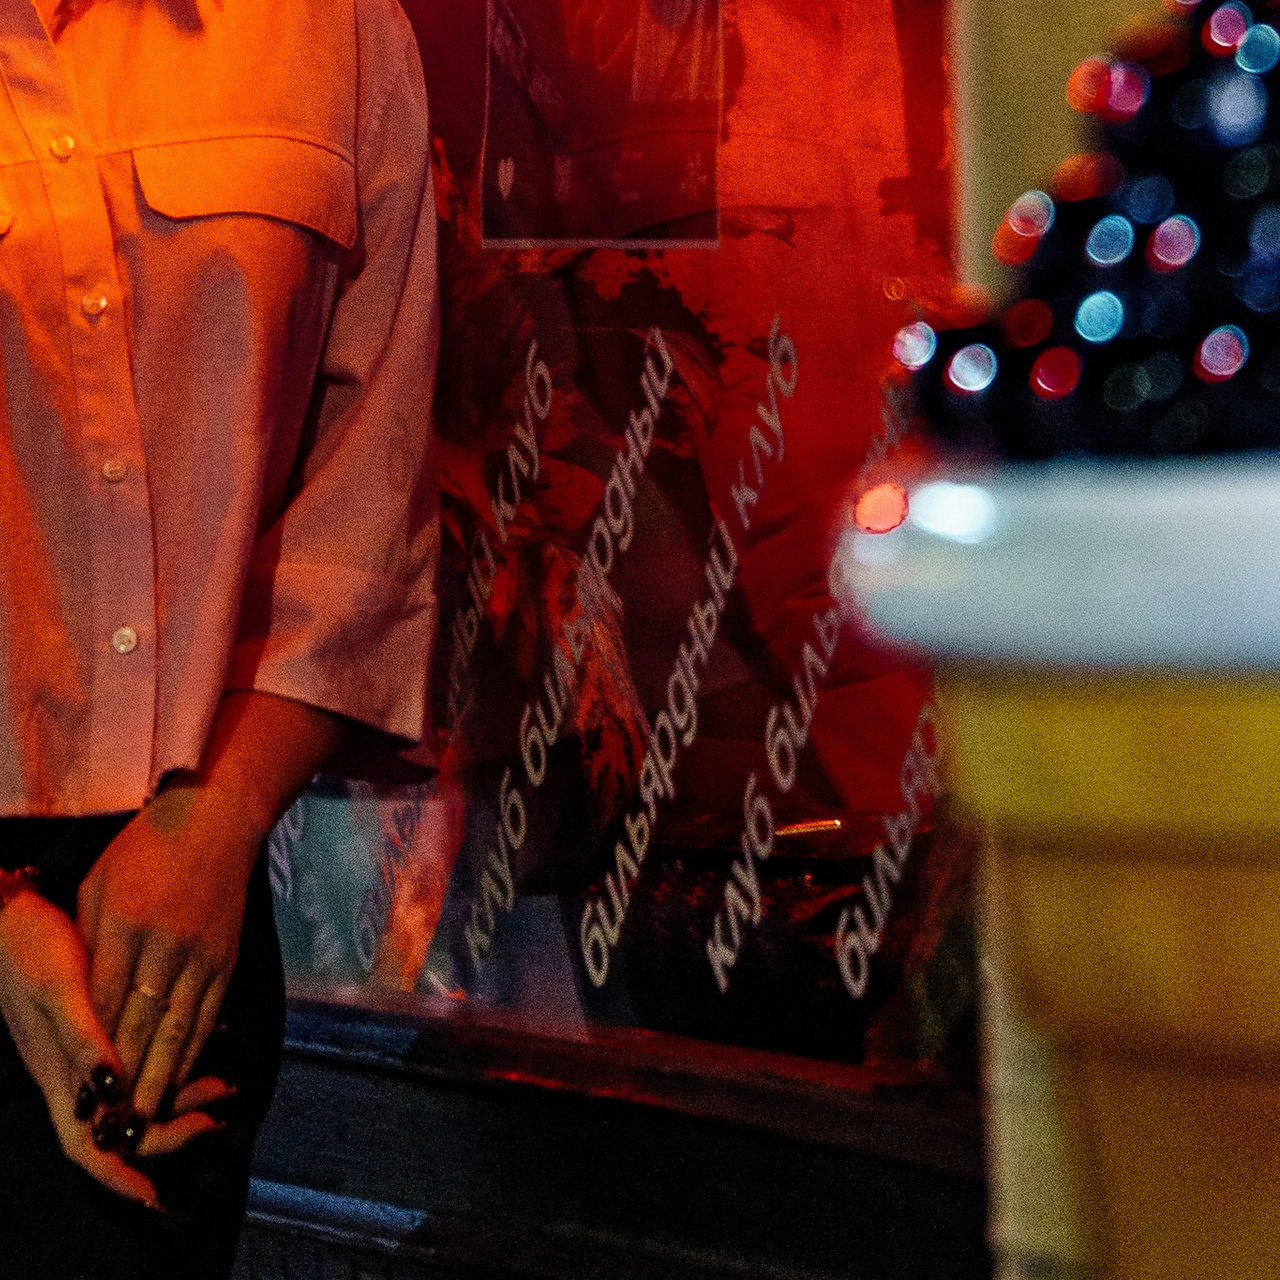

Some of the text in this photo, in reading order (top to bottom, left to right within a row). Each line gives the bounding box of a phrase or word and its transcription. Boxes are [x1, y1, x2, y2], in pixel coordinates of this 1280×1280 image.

[491, 339, 552, 543] клуб
[579, 313, 800, 988] бильярдный клуб
[463, 766, 527, 976] клуб
[706, 772, 776, 993] клуб
